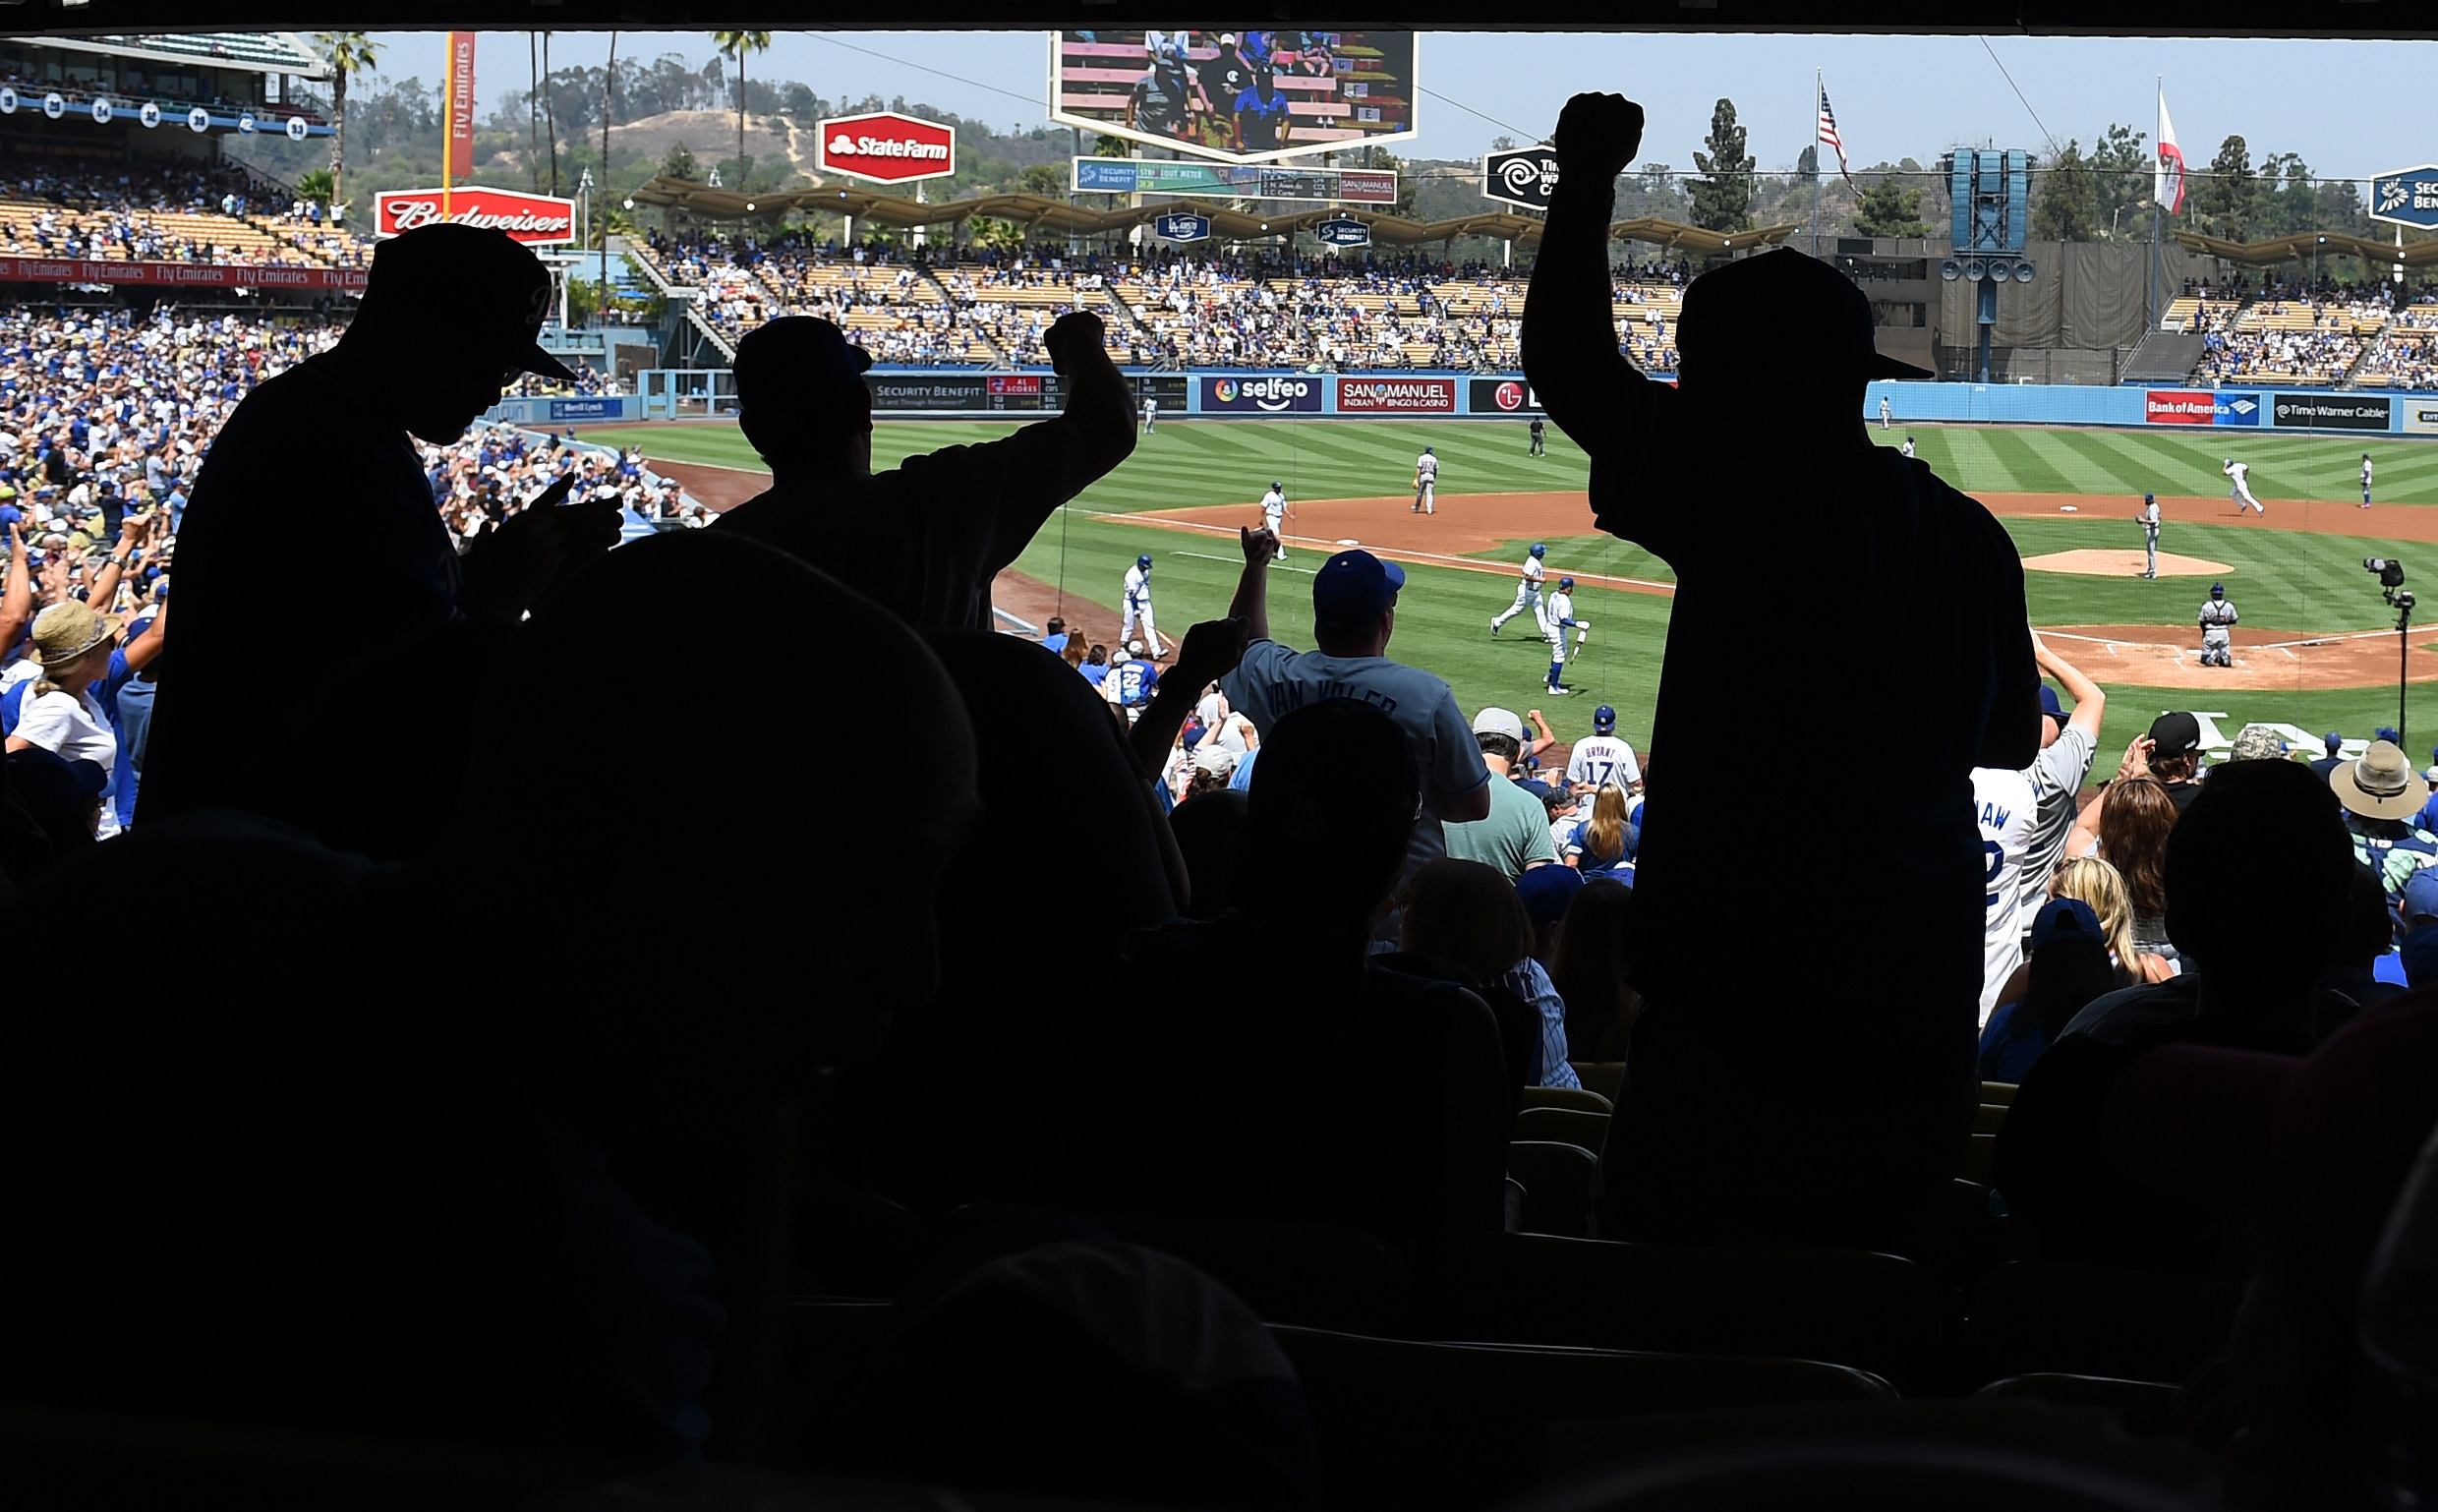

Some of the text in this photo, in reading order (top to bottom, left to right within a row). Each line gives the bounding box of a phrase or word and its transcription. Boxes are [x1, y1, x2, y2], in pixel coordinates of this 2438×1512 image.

[453, 42, 470, 139] Fly Emirates
[1099, 167, 1135, 175] SECURITY
[1099, 174, 1132, 183] BENEFIT
[1363, 181, 1393, 190] MANUEL
[2414, 181, 2438, 194] SEC
[2414, 196, 2438, 209] BEN
[18, 262, 72, 278] Fly Emirates
[83, 262, 144, 280] Fly Emirates
[156, 265, 223, 282] Fly Emirates
[236, 268, 308, 285] Fly Emirates
[323, 271, 369, 286] Fly Emi
[877, 385, 981, 397] SECURITY BENEFIT
[1344, 384, 1449, 398] SAN MANUEL
[1529, 386, 1542, 407] L
[585, 403, 603, 412] Lynch
[1387, 399, 1412, 407] BINGO
[2148, 402, 2230, 414] Bank of America
[2291, 405, 2385, 418] Time Warner Cable
[1122, 672, 1141, 689] 22
[1266, 680, 1303, 718] VAN
[1586, 746, 1616, 759] BRYANT
[1587, 761, 1614, 785] 17
[1975, 800, 2011, 831] AW
